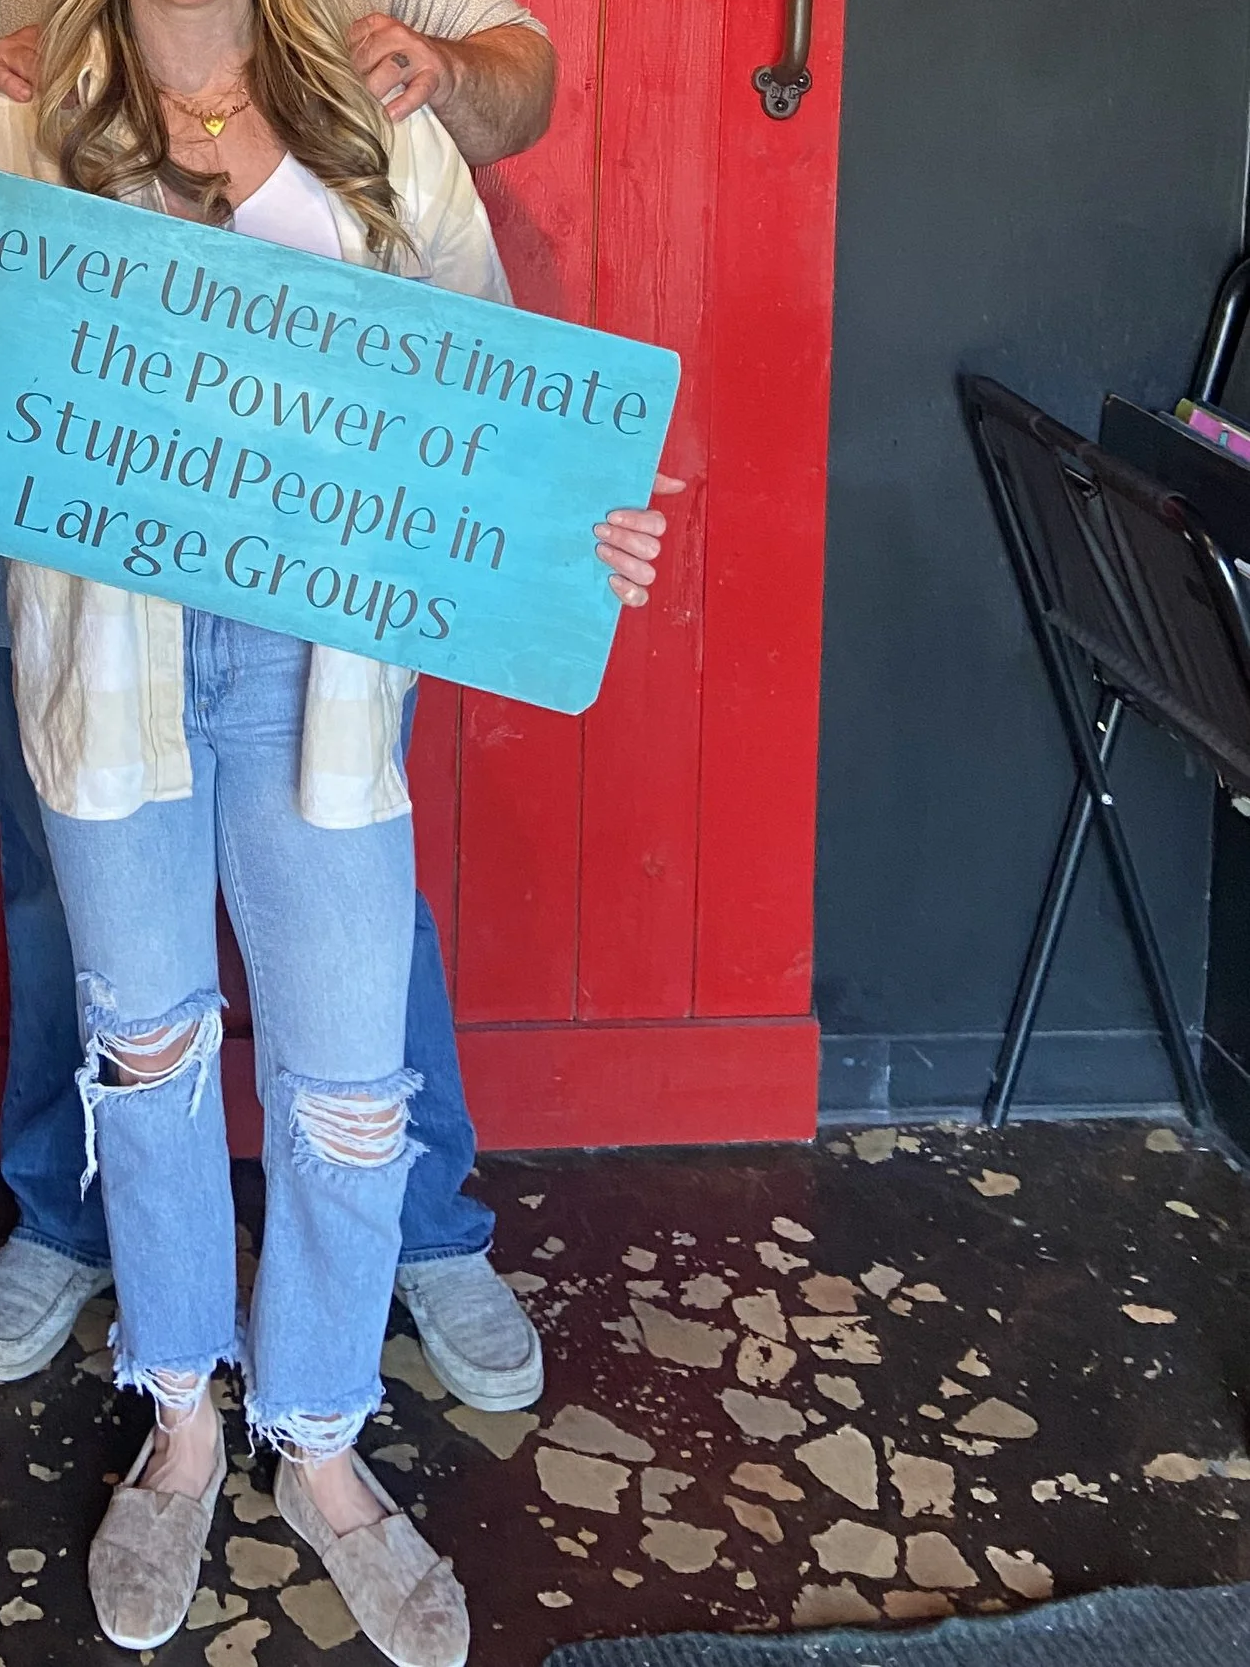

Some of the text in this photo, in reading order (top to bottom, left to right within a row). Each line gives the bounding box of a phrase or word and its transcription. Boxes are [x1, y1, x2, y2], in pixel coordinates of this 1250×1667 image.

[70, 319, 499, 477] the Power of
[160, 259, 648, 435] Underestimate
[6, 390, 507, 571] Stupid People in
[13, 475, 458, 641] Large Groups
